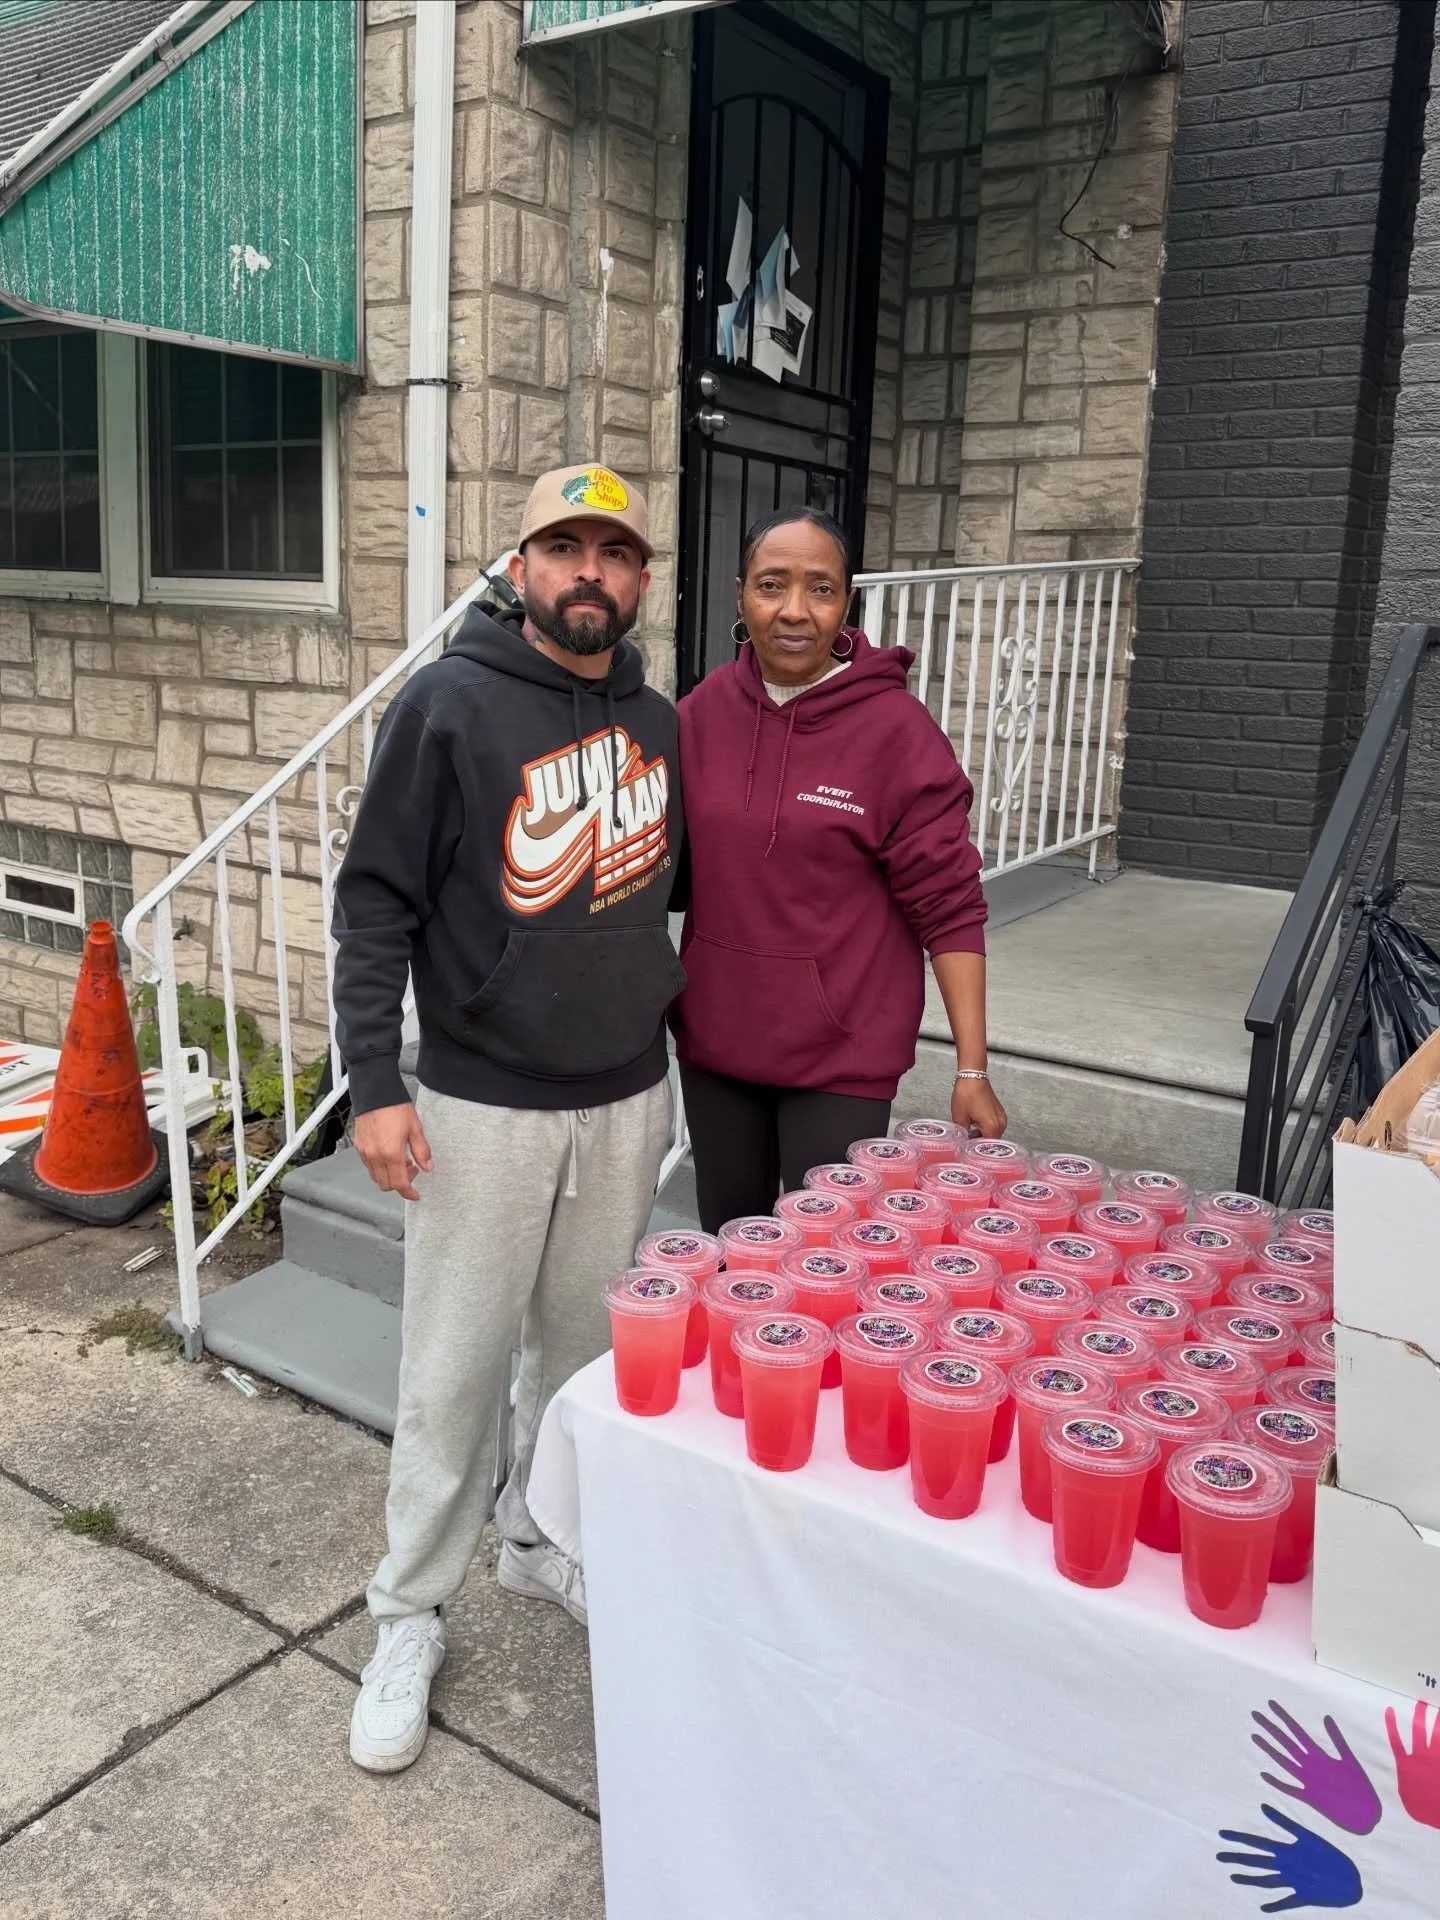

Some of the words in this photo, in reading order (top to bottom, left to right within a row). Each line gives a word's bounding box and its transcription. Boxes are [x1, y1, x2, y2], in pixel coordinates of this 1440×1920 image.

[594, 470, 619, 487] Bass
[594, 481, 613, 493] Pro
[594, 491, 624, 508] Shops
[816, 785, 853, 799] EVENT
[796, 793, 865, 815] COORDINATOR
[589, 897, 606, 915] NBA
[607, 885, 630, 906] WORLD
